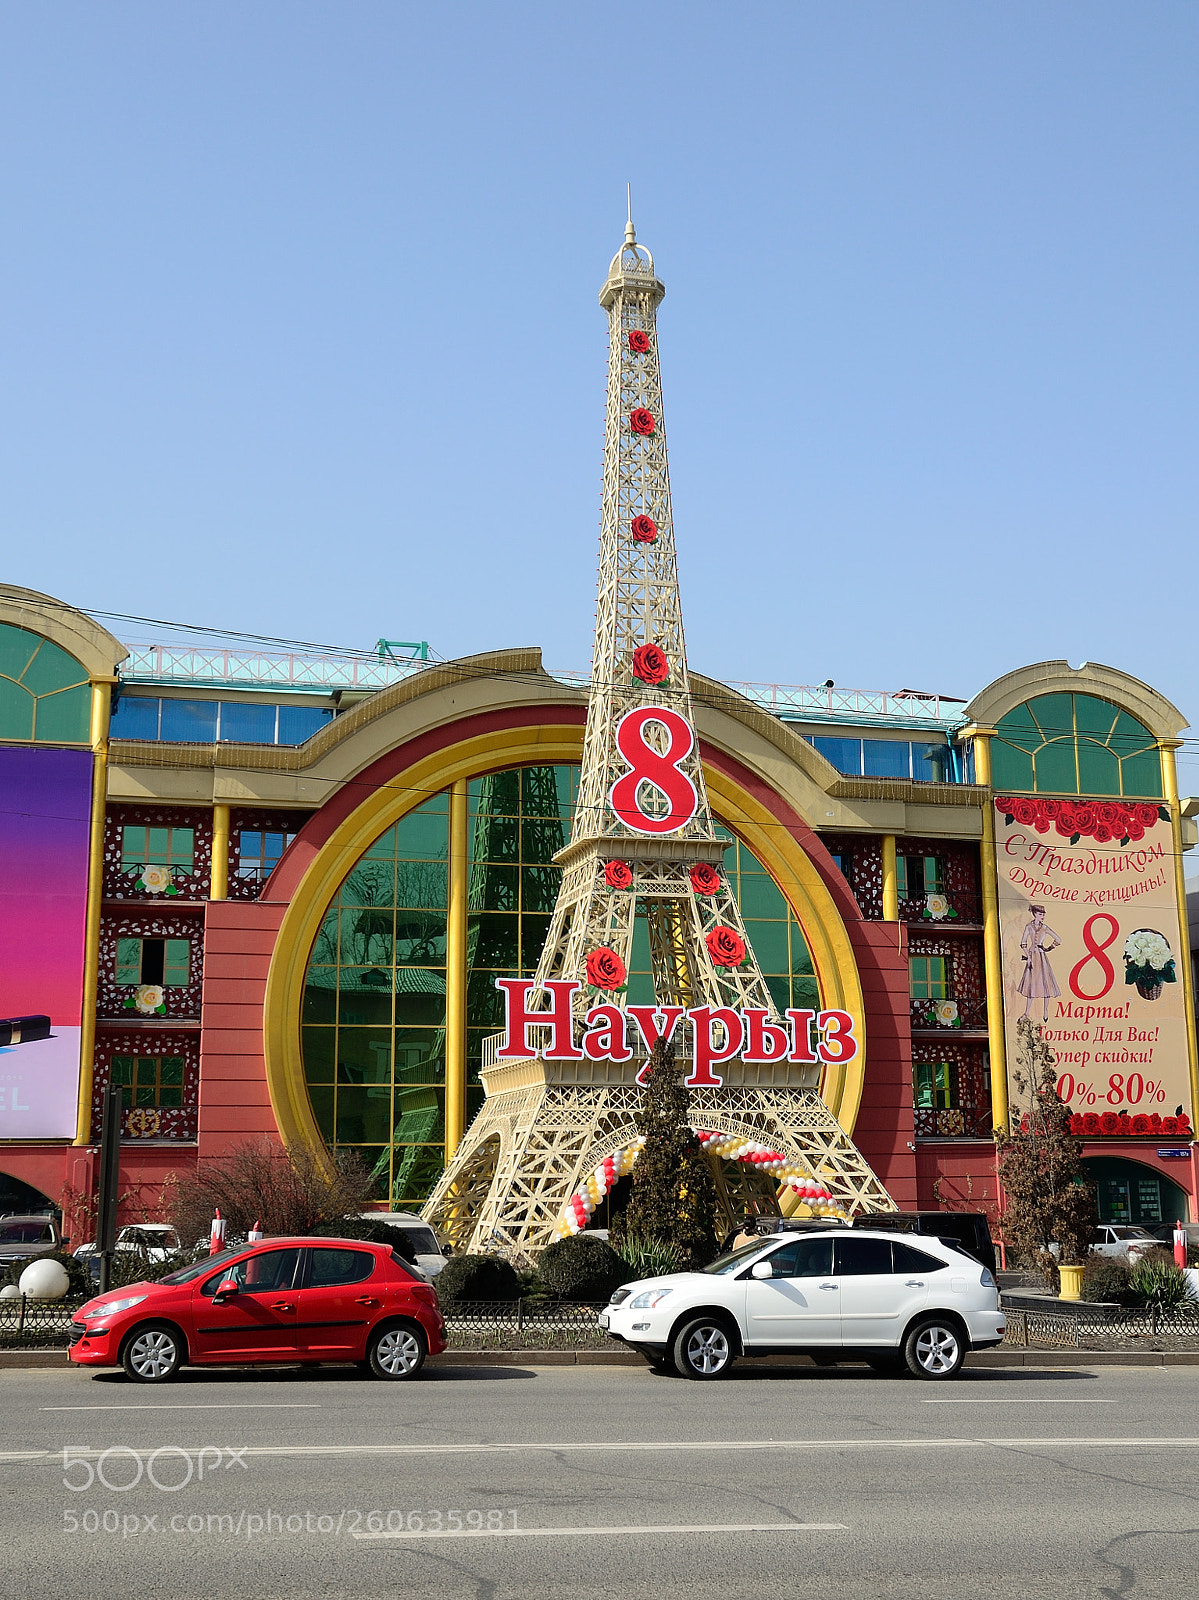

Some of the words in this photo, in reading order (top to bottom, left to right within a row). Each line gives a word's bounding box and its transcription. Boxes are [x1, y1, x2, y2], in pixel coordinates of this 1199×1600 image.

[609, 705, 699, 835] 8
[1004, 833, 1027, 856] С
[1023, 842, 1166, 877] Праздником
[1008, 866, 1079, 901] Дорогие
[1082, 868, 1167, 907] женщины!
[1068, 912, 1120, 1001] 8
[495, 978, 858, 1088] Наурыз
[1054, 1001, 1131, 1027] Марта!
[1092, 1026, 1123, 1044] Для
[1126, 1026, 1160, 1042] Вас!
[1094, 1047, 1154, 1064] скидки!
[1038, 1072, 1166, 1106] 0%-80%
